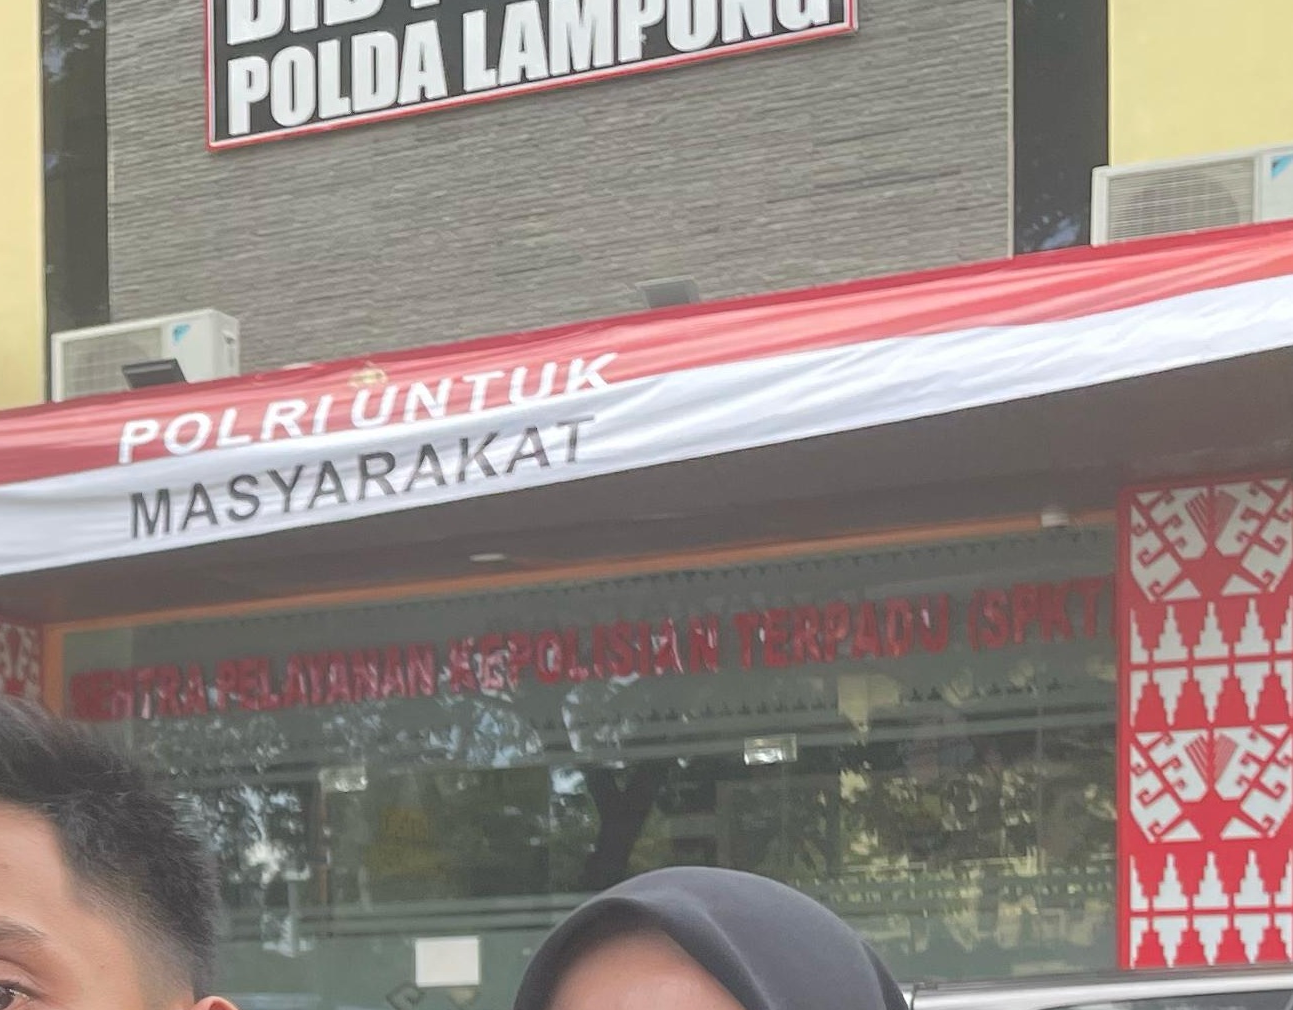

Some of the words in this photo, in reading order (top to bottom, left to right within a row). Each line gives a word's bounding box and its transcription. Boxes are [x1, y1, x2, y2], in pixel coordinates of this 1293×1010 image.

[227, 19, 448, 135] POLDA
[118, 393, 332, 465] POLRI
[349, 352, 619, 428] UNTUK
[130, 414, 595, 540] MASYARAKAT
[215, 642, 436, 711] PELAYANAN
[448, 614, 719, 694] KEPOLISIAN
[734, 593, 951, 671] TERPADU
